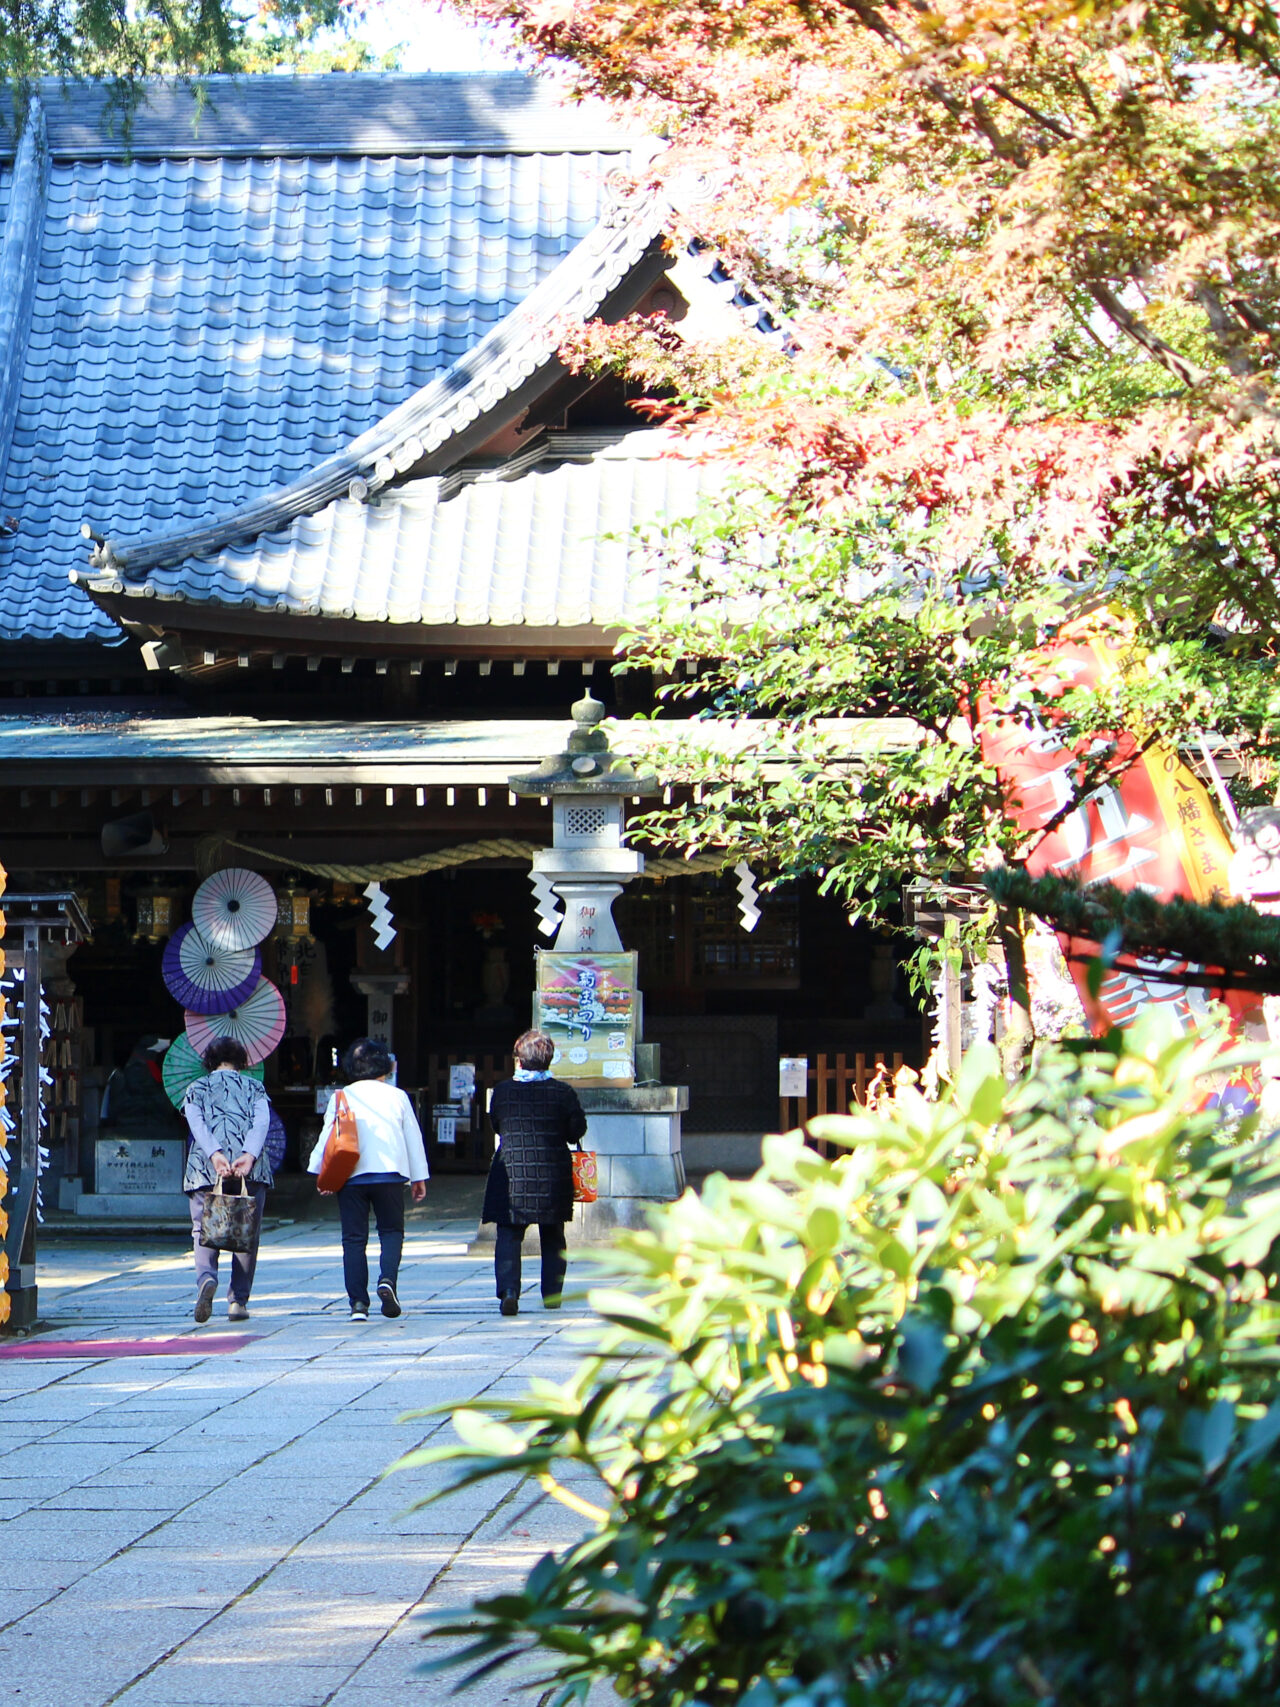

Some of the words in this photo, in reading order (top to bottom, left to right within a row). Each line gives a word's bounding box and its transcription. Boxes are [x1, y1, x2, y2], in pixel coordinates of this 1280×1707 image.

[579, 905, 596, 951] 御神
[578, 970, 597, 1041] 菊まつり
